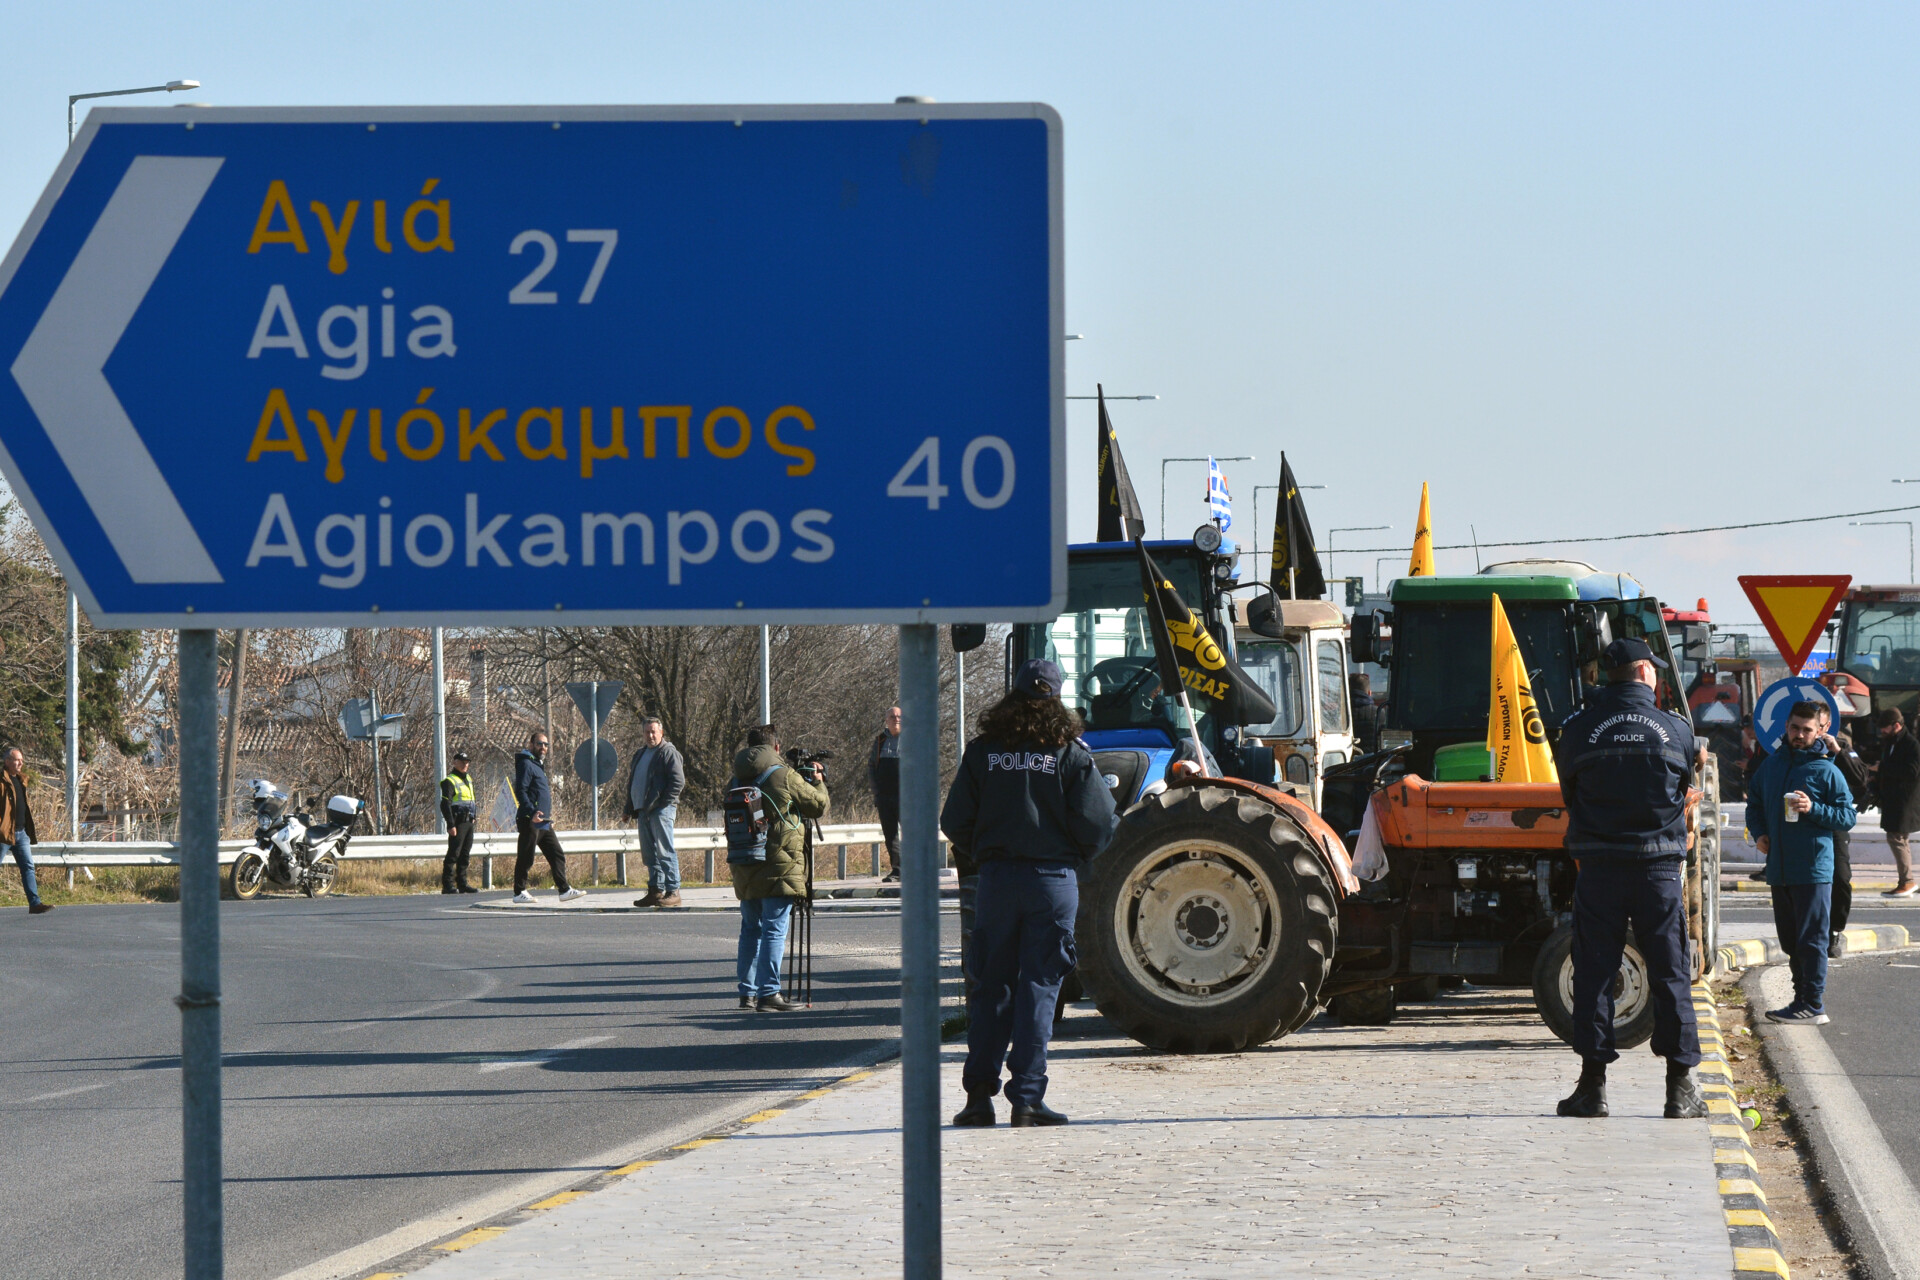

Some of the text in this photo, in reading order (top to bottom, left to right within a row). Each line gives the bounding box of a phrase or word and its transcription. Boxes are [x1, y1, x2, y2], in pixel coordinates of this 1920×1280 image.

[247, 179, 455, 274] Αγιά
[509, 229, 619, 304] 27
[247, 285, 457, 380] Agia
[246, 388, 816, 483] Αγιόκαμπος
[887, 435, 1016, 510] 40
[245, 493, 835, 588] Agiokampos
[1179, 666, 1230, 700] ΡΙΣΑΣ
[1498, 695, 1511, 740] ΑΓΡΟΤΙΚΩΝ
[987, 752, 1057, 775] POLICE
[1588, 713, 1670, 744] ΕΛΛΗΝΙΚΗ ΑΣΤΥΝΟΜΙΑ
[1613, 734, 1645, 742] POLICE
